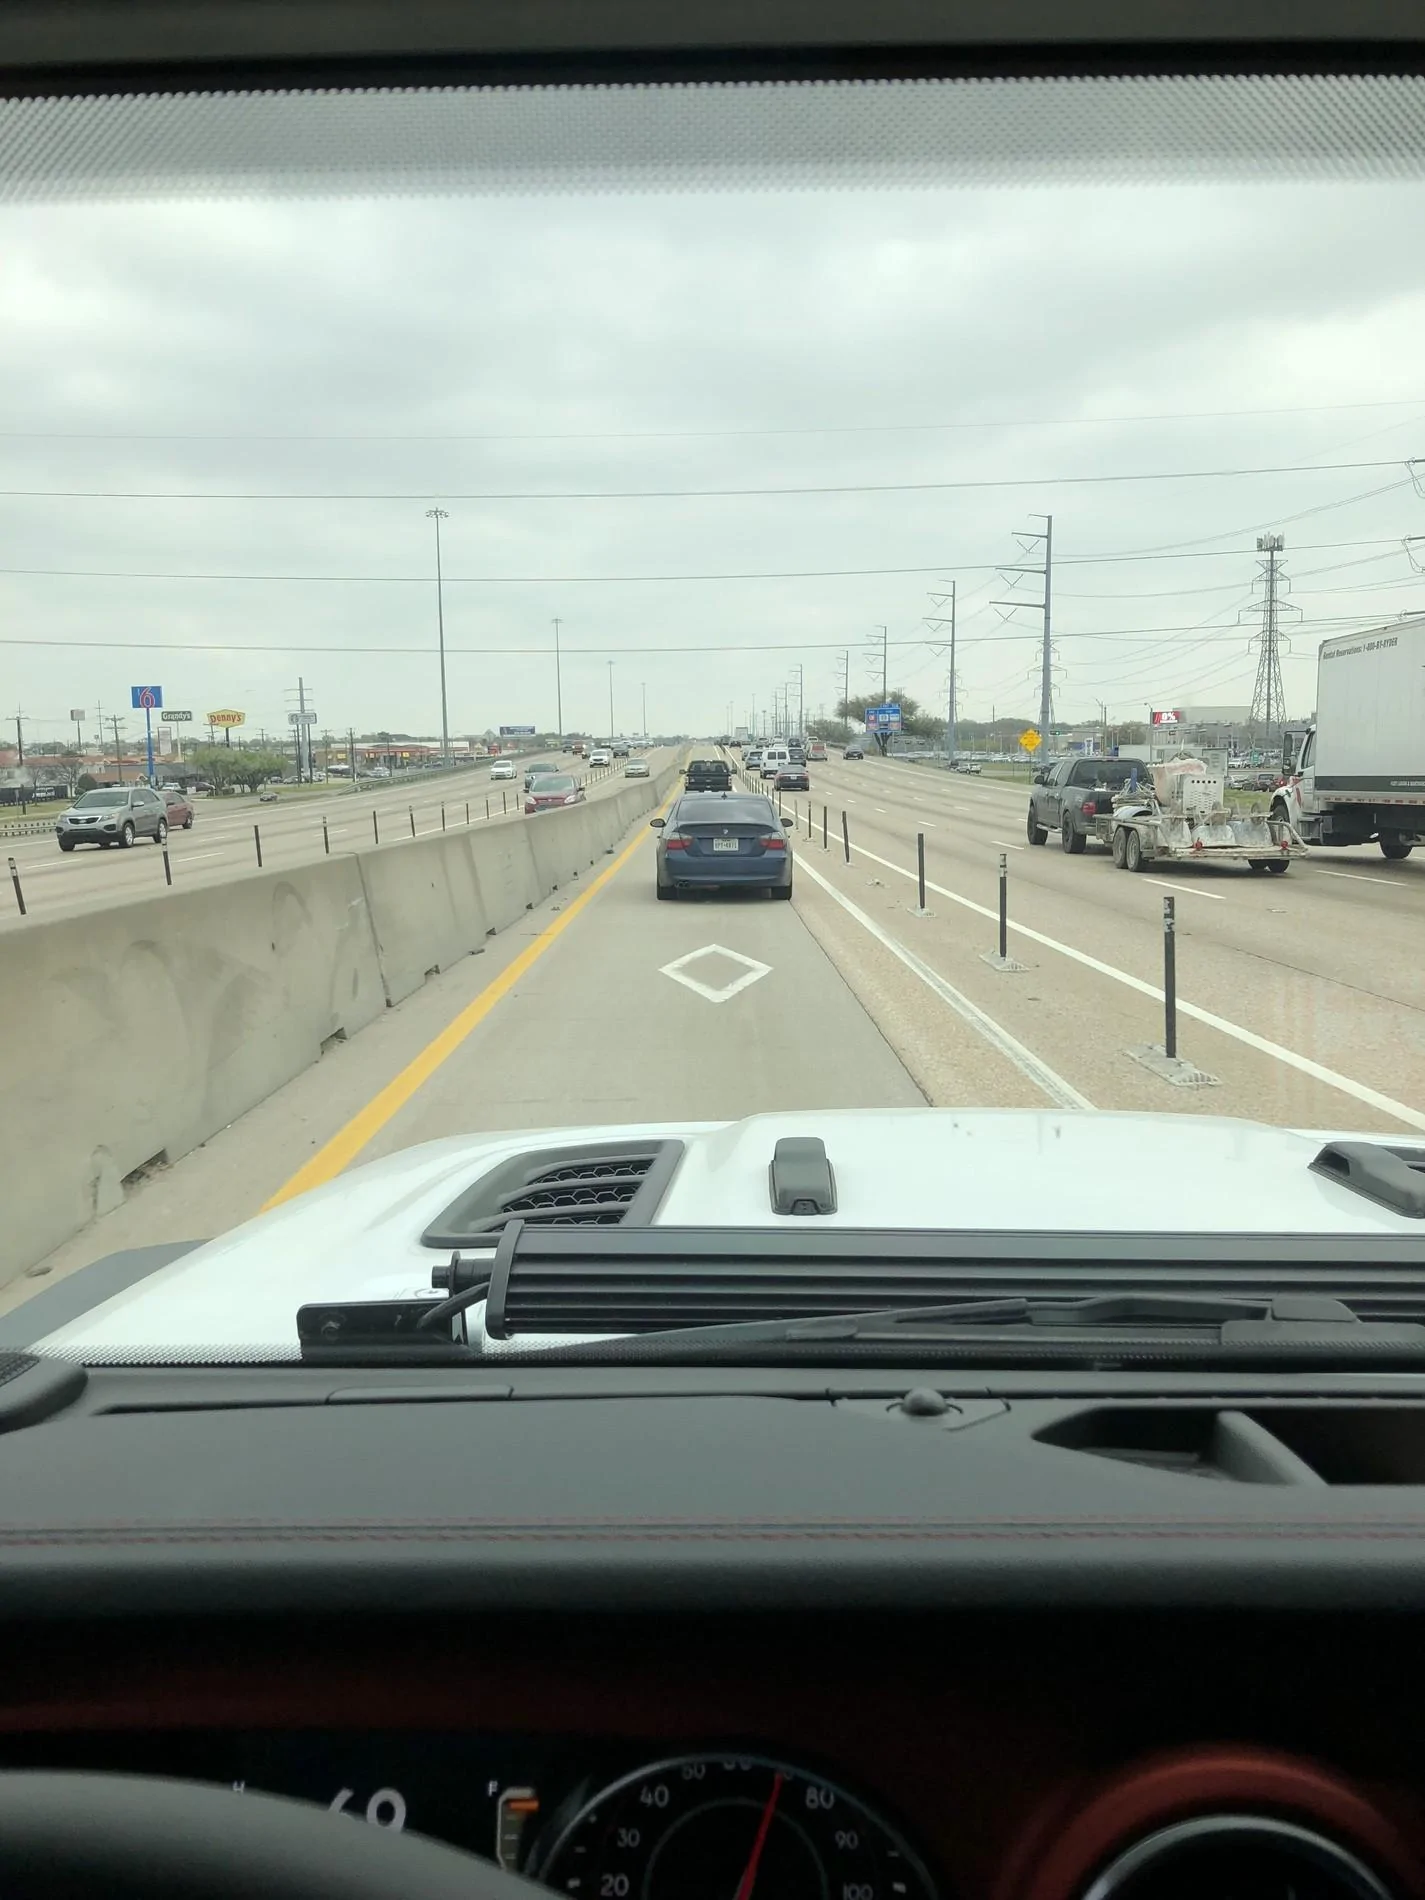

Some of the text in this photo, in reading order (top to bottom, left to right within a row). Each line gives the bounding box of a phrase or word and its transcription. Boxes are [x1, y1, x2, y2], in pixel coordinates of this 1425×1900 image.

[140, 687, 155, 708] 6
[162, 712, 191, 720] Grandy's
[209, 712, 242, 723] Denny's
[640, 1784, 669, 1808] 40
[805, 1786, 834, 1810] 80
[617, 1827, 640, 1848] 30
[835, 1829, 858, 1850] 90
[600, 1873, 630, 1898] 20
[843, 1882, 873, 1900] 100
